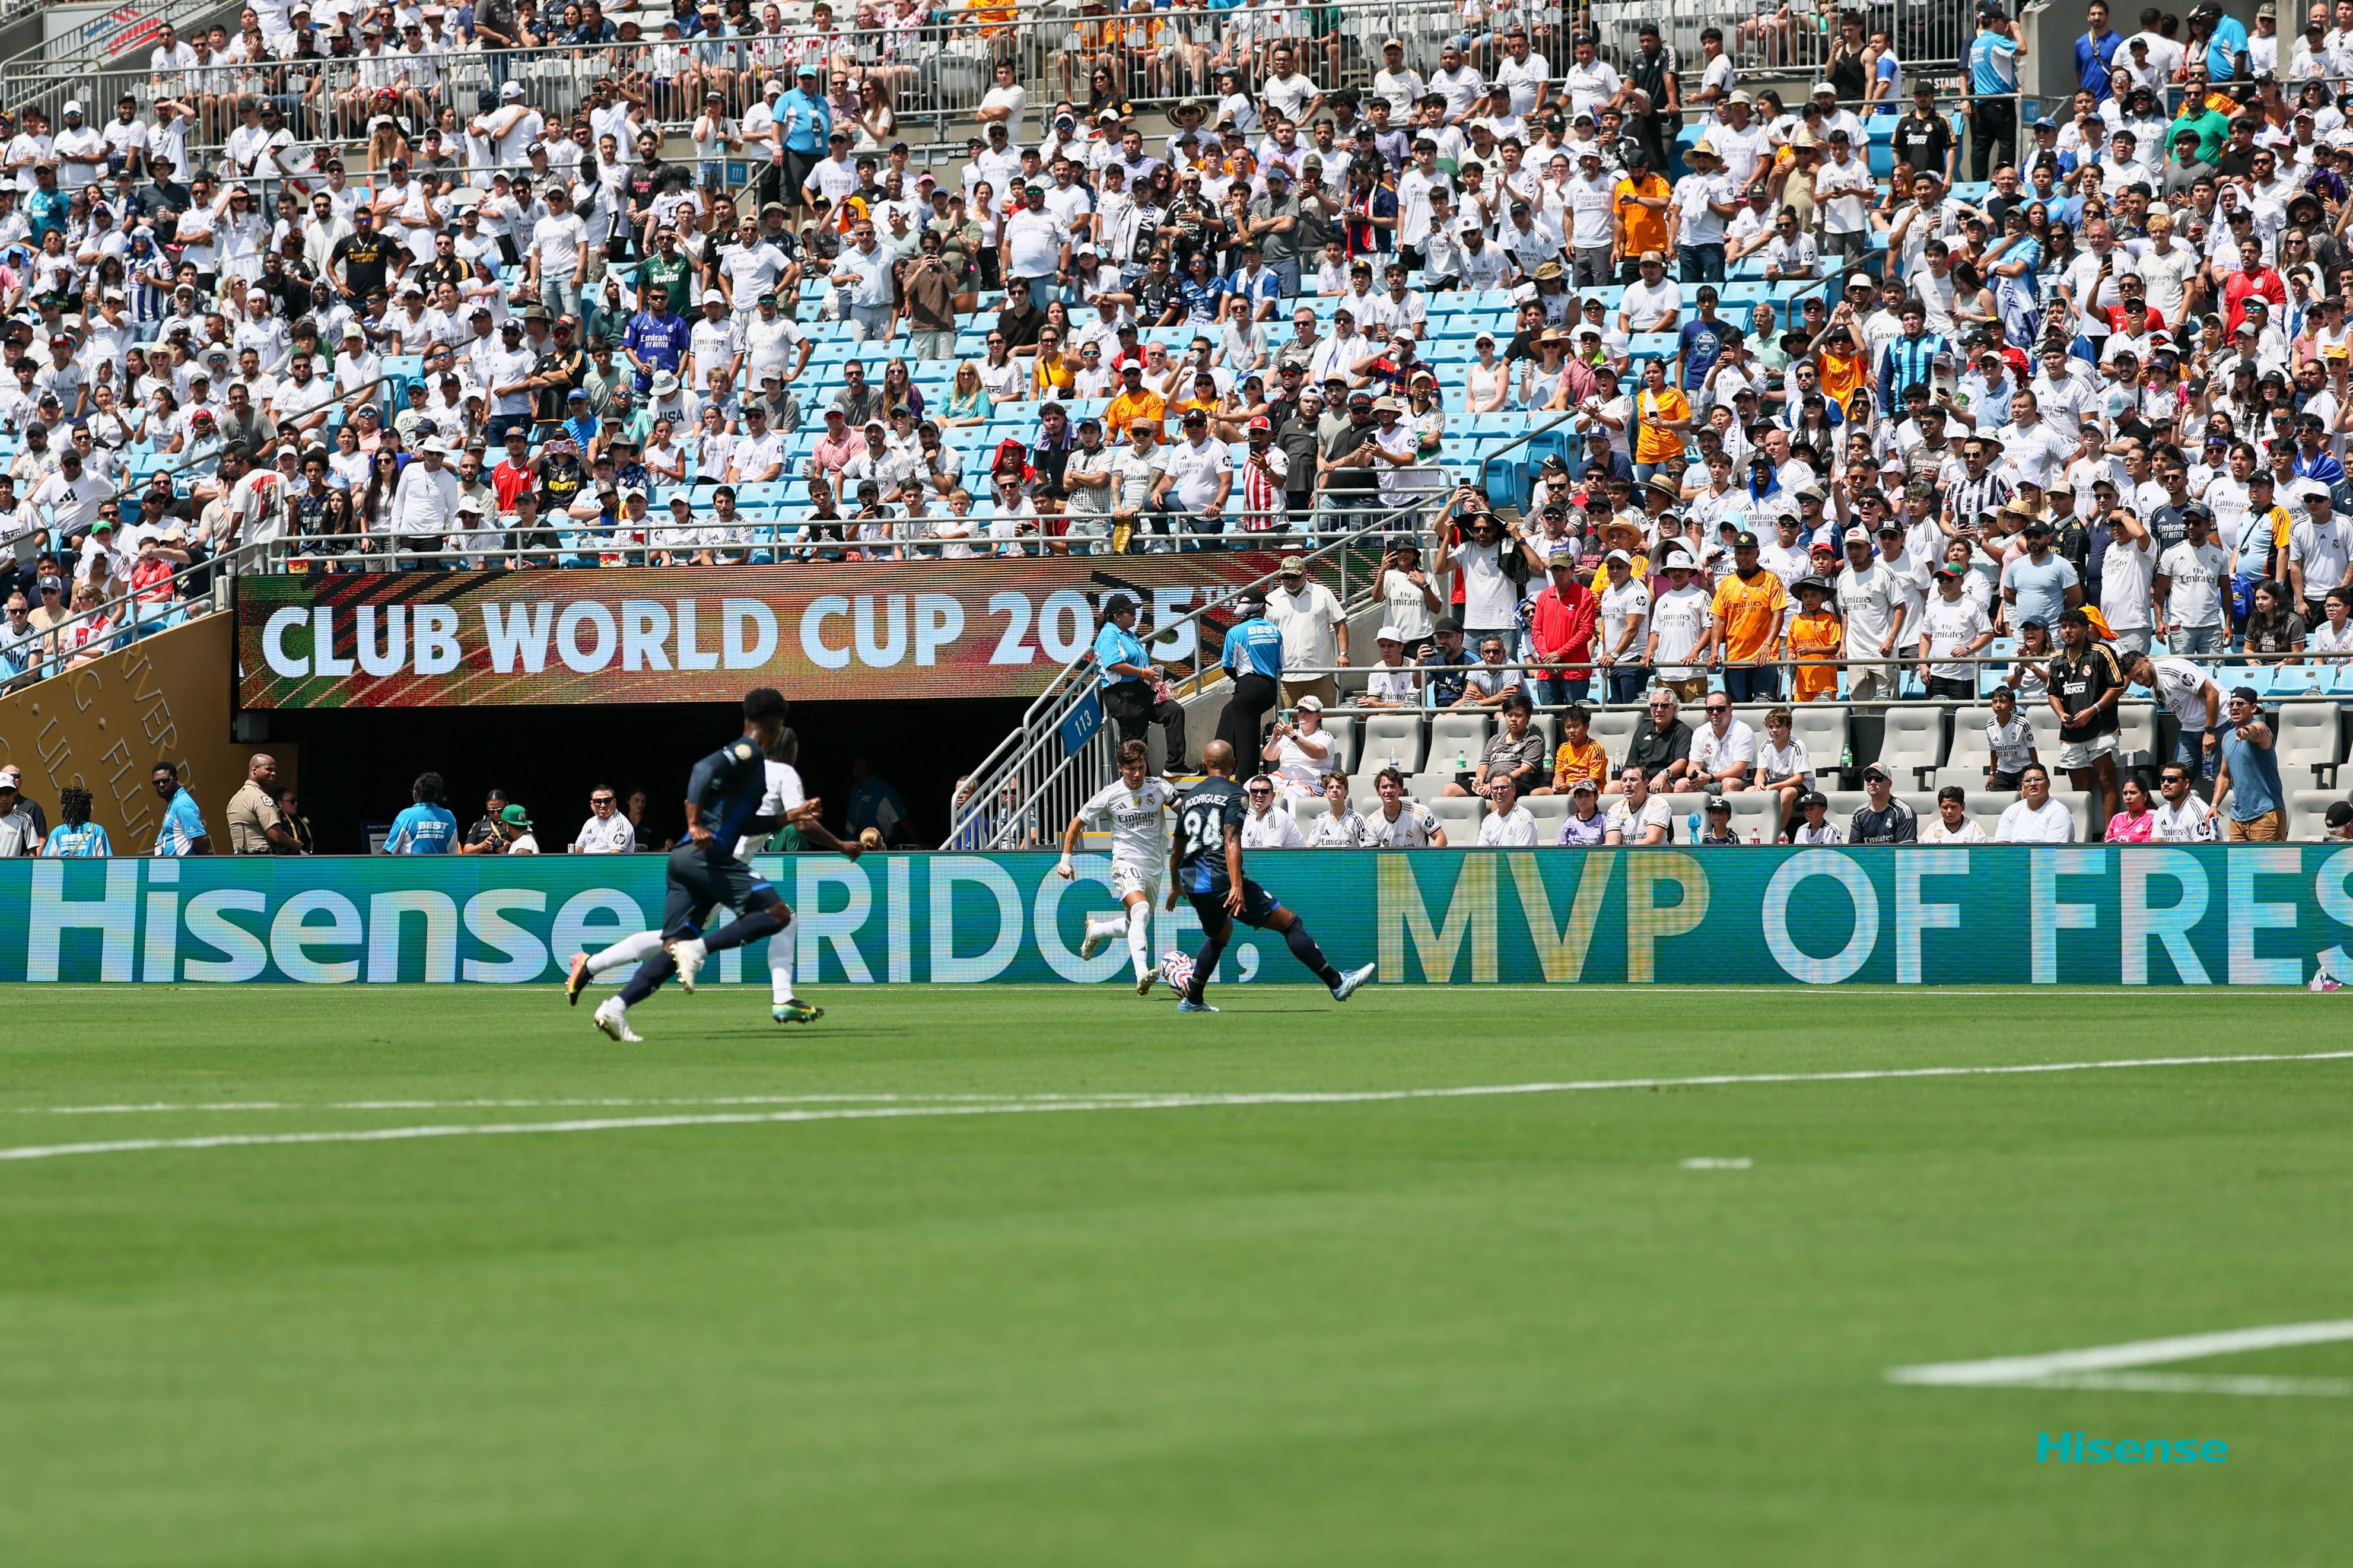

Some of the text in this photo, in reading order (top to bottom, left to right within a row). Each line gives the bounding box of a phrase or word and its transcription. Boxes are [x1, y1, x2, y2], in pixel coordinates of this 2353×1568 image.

[2026, 106, 2036, 116] 112
[1906, 133, 1928, 145] Teka
[732, 168, 742, 179] 111
[653, 272, 679, 283] bwin
[1544, 316, 1561, 326] win
[641, 334, 672, 343] Emirates
[660, 409, 685, 424] USA
[1911, 459, 1941, 467] Emirates
[2215, 499, 2249, 507] Emirates
[1744, 513, 1778, 521] Emirates
[2158, 524, 2187, 533] Emirate
[2180, 574, 2215, 584] Emirates
[1400, 591, 1412, 600] Fly
[1843, 596, 1871, 605] Emirates
[1388, 597, 1423, 607] Emirates
[1728, 600, 1762, 609] Emirates
[1660, 611, 1690, 621] Emirates
[262, 603, 463, 678] CLUB
[481, 598, 779, 673] WORLD
[799, 592, 965, 670] CUP
[1247, 625, 1279, 635] BEST
[2063, 682, 2088, 696] Teka
[1379, 692, 1406, 700] Emirates
[1074, 710, 1092, 737] 113
[1185, 794, 1228, 810] RODRIGUEZ
[1118, 809, 1159, 823] Emirates
[417, 822, 449, 830] BEST
[1126, 819, 1154, 830] FLY BETTER
[1184, 808, 1223, 854] 24
[62, 834, 93, 842] BEST
[613, 832, 625, 845] hp
[1321, 837, 1352, 846] Emirates
[1864, 833, 1894, 843] Emirates
[26, 858, 648, 985] Hisense
[1376, 851, 1710, 983] MVP
[1761, 848, 1970, 985] OF
